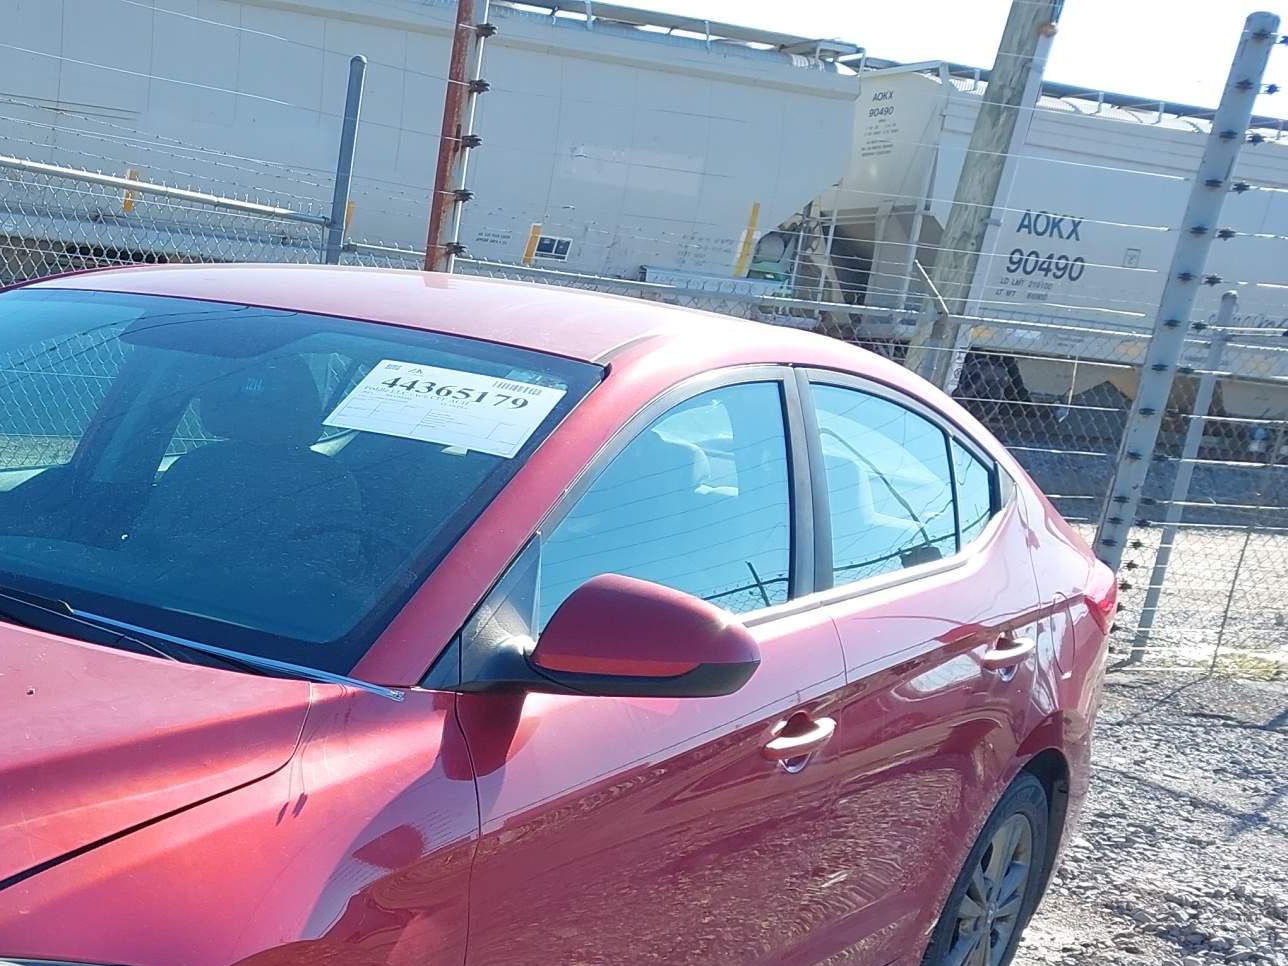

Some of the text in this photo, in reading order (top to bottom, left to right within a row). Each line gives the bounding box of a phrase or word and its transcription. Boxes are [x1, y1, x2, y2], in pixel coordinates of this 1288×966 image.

[868, 106, 895, 118] 90490
[872, 90, 894, 102] AOKX
[1016, 209, 1084, 241] AOKX
[1006, 248, 1086, 282] 90490
[382, 377, 529, 409] 44365179
